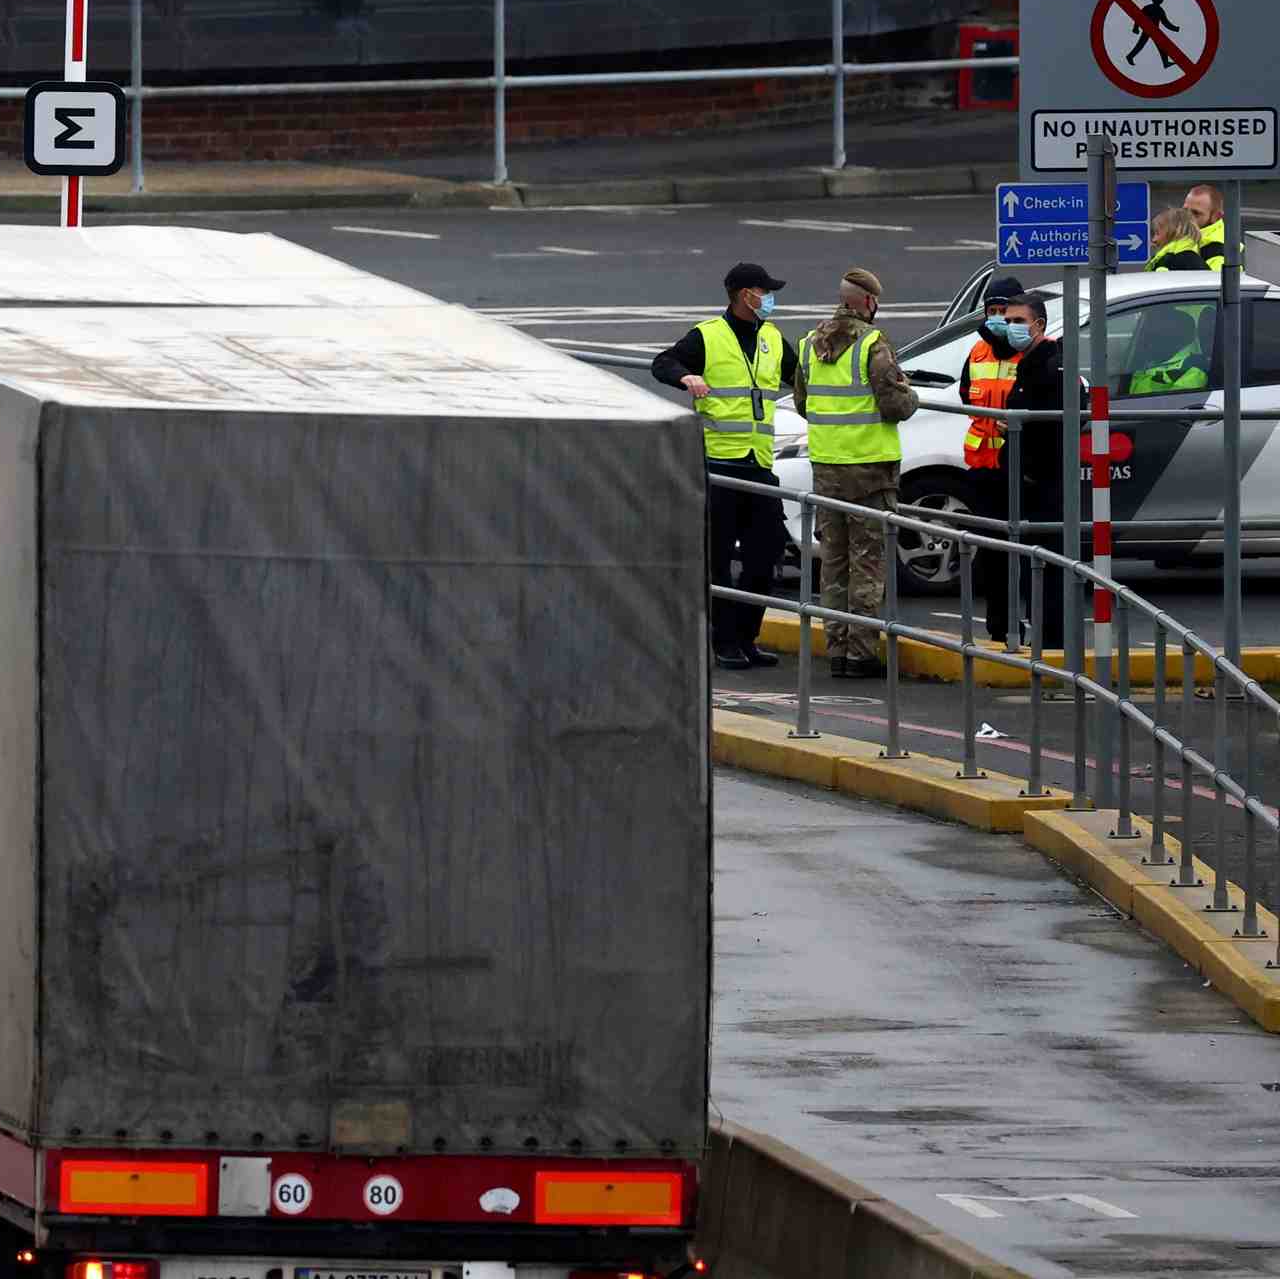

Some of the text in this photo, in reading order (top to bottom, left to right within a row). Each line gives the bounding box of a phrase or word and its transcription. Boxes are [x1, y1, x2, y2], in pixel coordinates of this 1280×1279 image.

[1043, 118, 1267, 138] NO UNAUTHORISED
[1076, 141, 1235, 159] PDESTRIANS
[1023, 196, 1084, 209] Check-in
[1030, 229, 1089, 242] Authoris
[278, 1183, 305, 1204] 60
[369, 1184, 397, 1206] 80
